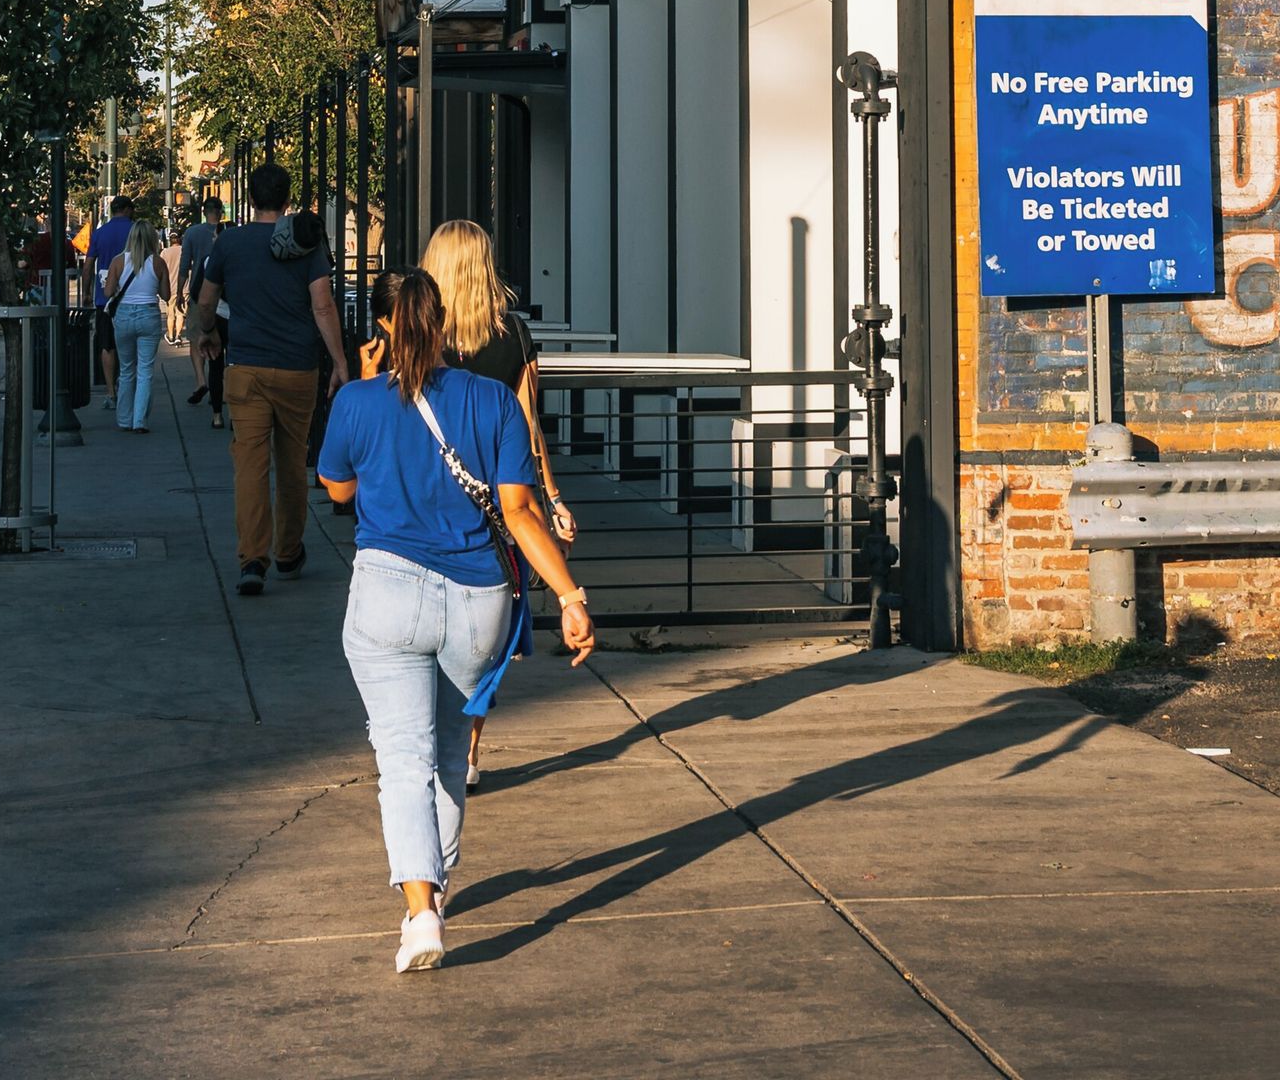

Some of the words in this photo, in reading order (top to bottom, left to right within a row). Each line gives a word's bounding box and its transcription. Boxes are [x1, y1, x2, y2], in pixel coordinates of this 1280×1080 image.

[991, 73, 1027, 93] No
[1034, 72, 1089, 94] Free
[1096, 71, 1194, 98] Parking
[1037, 102, 1149, 131] Anytime
[1007, 166, 1124, 189] Violators
[1132, 165, 1182, 187] Will
[1022, 200, 1054, 220] Be
[1061, 196, 1169, 220] Ticketed
[1037, 235, 1065, 251] or
[1072, 228, 1156, 251] Towed
